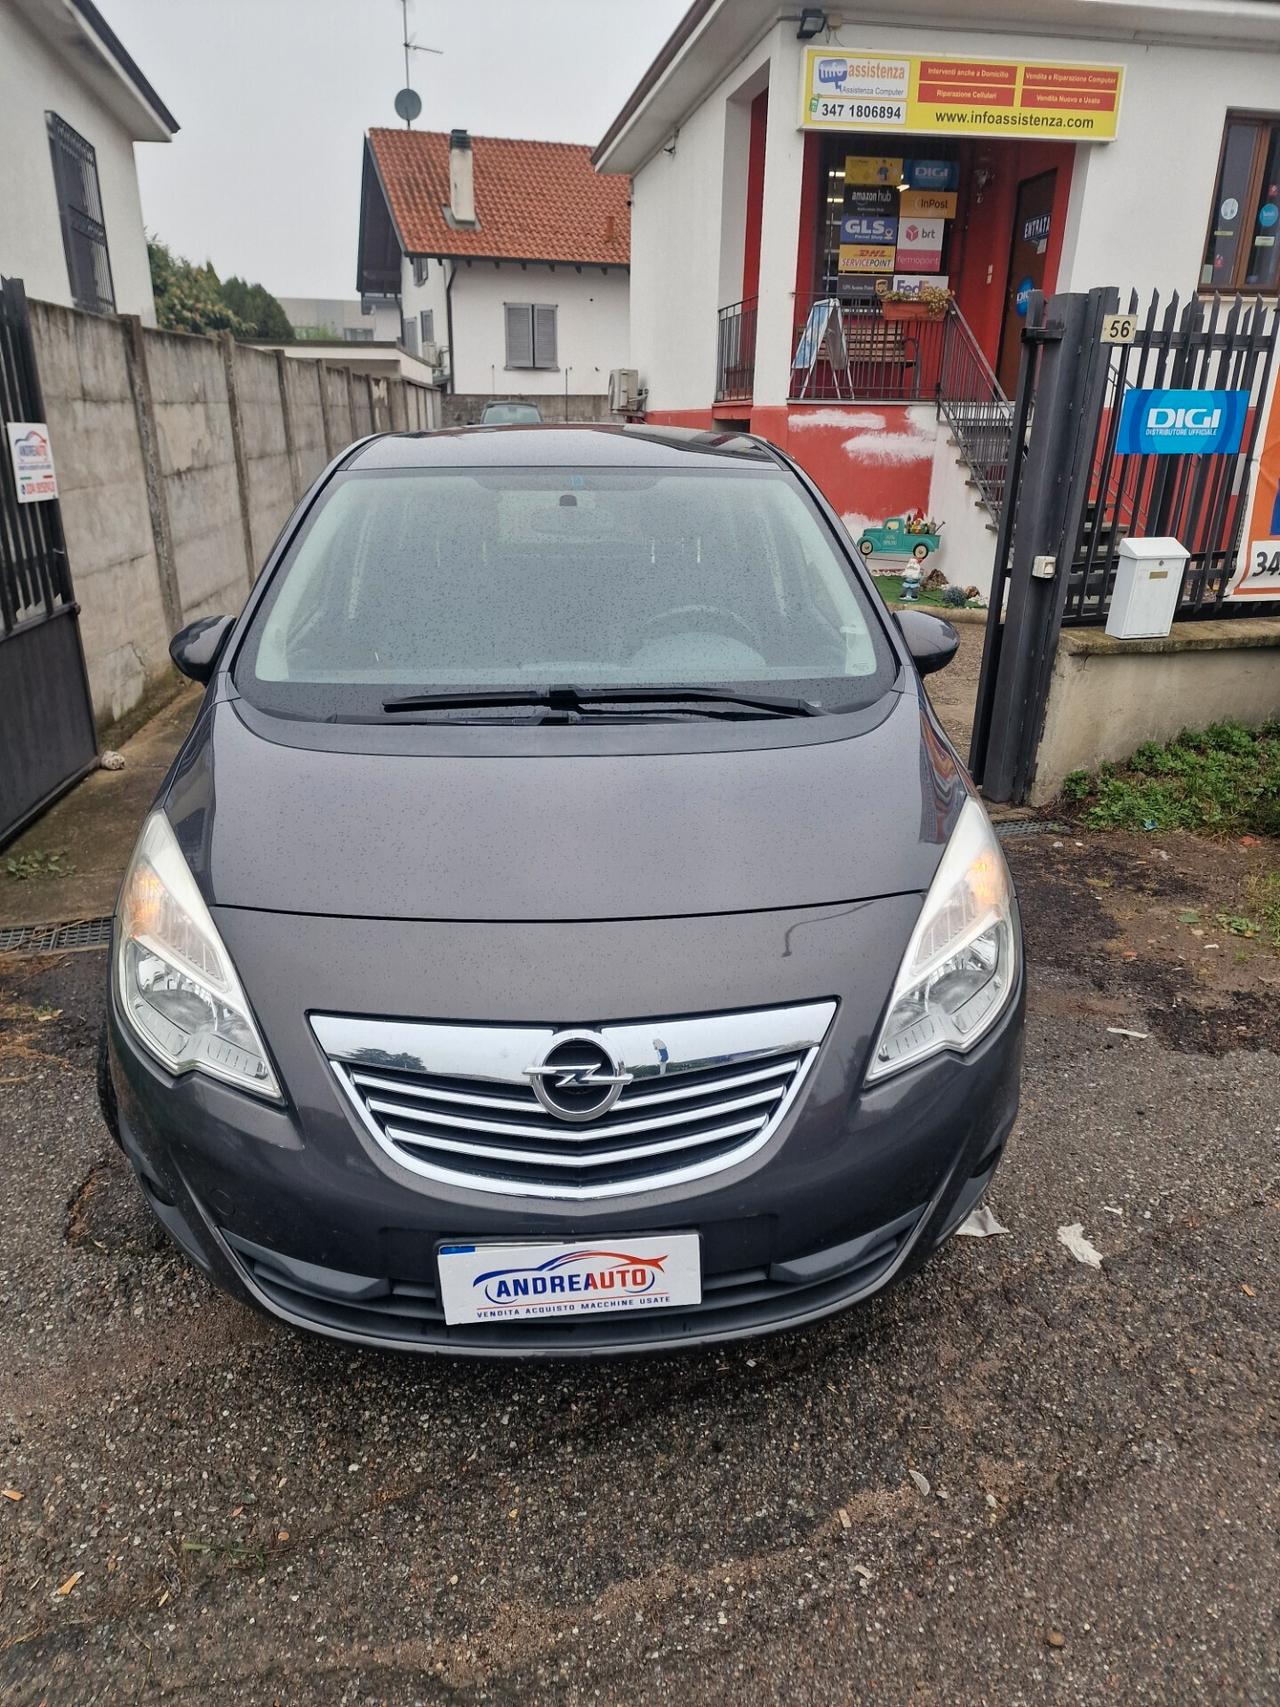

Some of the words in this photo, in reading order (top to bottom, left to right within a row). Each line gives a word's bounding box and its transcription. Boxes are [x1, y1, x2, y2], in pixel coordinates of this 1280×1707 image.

[848, 61, 905, 80] assistenza
[981, 69, 1009, 78] Domicilio
[1053, 73, 1087, 83] Riparazione
[842, 86, 873, 95] Assistenza
[875, 87, 904, 97] Computer
[936, 89, 971, 98] Riparazione
[822, 103, 845, 118] 347
[849, 104, 902, 120] 1806894
[936, 112, 1094, 128] www.infoassistenza.com
[915, 167, 948, 177] DIGI
[852, 191, 877, 201] amazon
[878, 189, 892, 203] hub
[921, 199, 948, 209] InPost
[846, 219, 885, 234] GLS
[921, 228, 936, 239] brt
[1024, 215, 1051, 239] ENTRATA
[842, 258, 891, 267] SERVICEPOINT
[1109, 320, 1131, 338] 56
[1147, 408, 1221, 428] DIGI
[1145, 428, 1187, 436] DISTRIBUTORE
[496, 1268, 647, 1298] ANDREAUTO
[477, 1308, 520, 1318] VENDITA
[525, 1305, 575, 1314] ACQUISTO
[580, 1300, 634, 1310] MACCHINE
[639, 1296, 671, 1304] USATE
